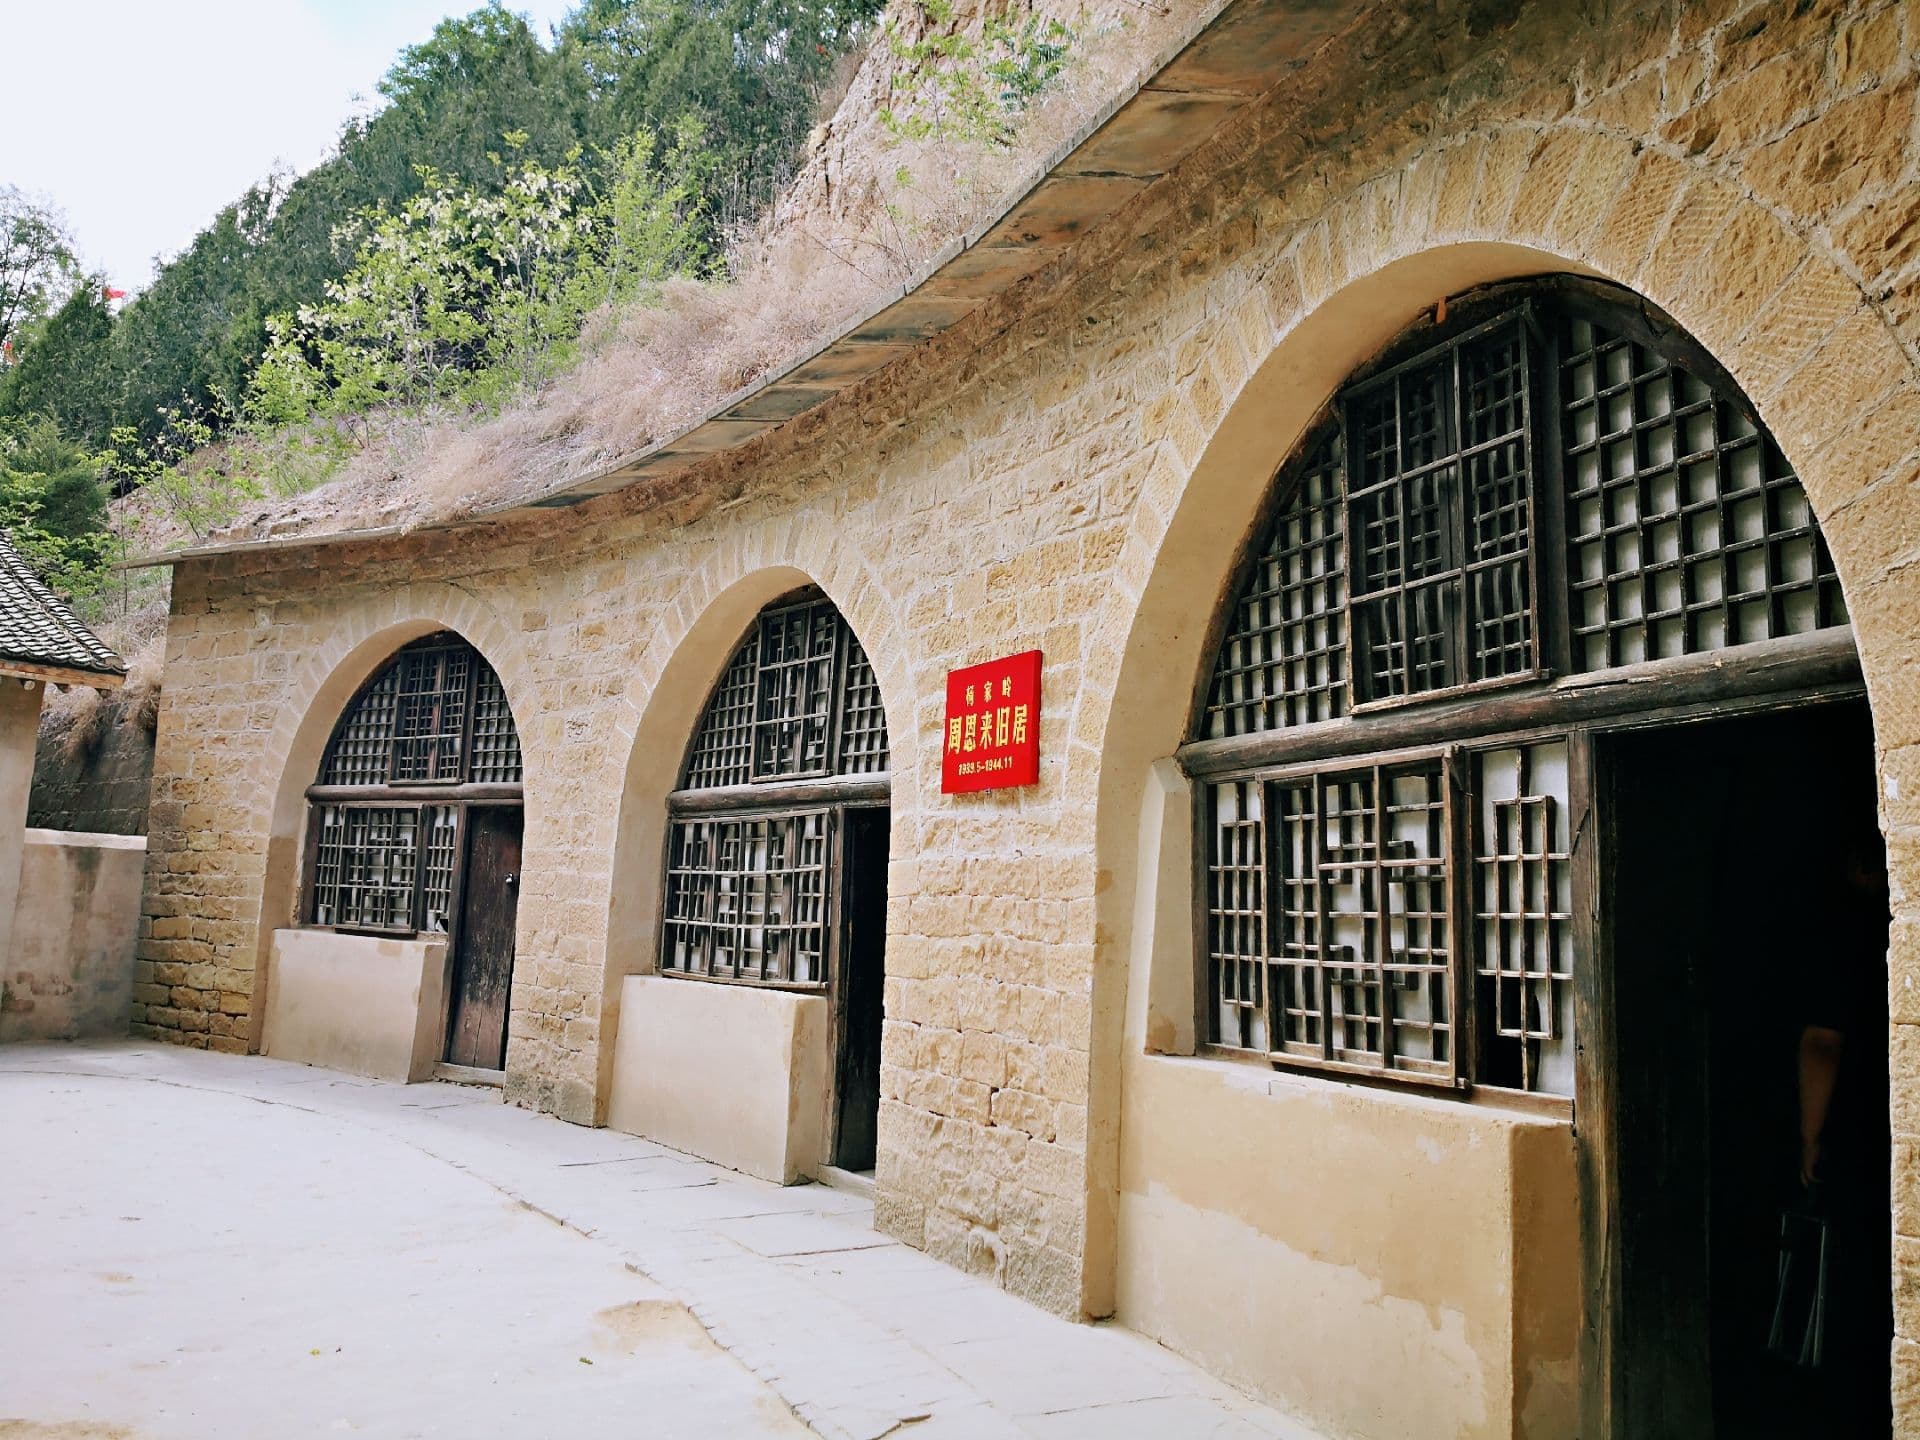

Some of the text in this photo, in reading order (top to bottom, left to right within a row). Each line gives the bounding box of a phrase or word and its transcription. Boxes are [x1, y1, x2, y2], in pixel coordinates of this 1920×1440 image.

[947, 703, 1027, 755] 周恩来旧居
[958, 756, 1013, 776] 1939.5-1944.11
